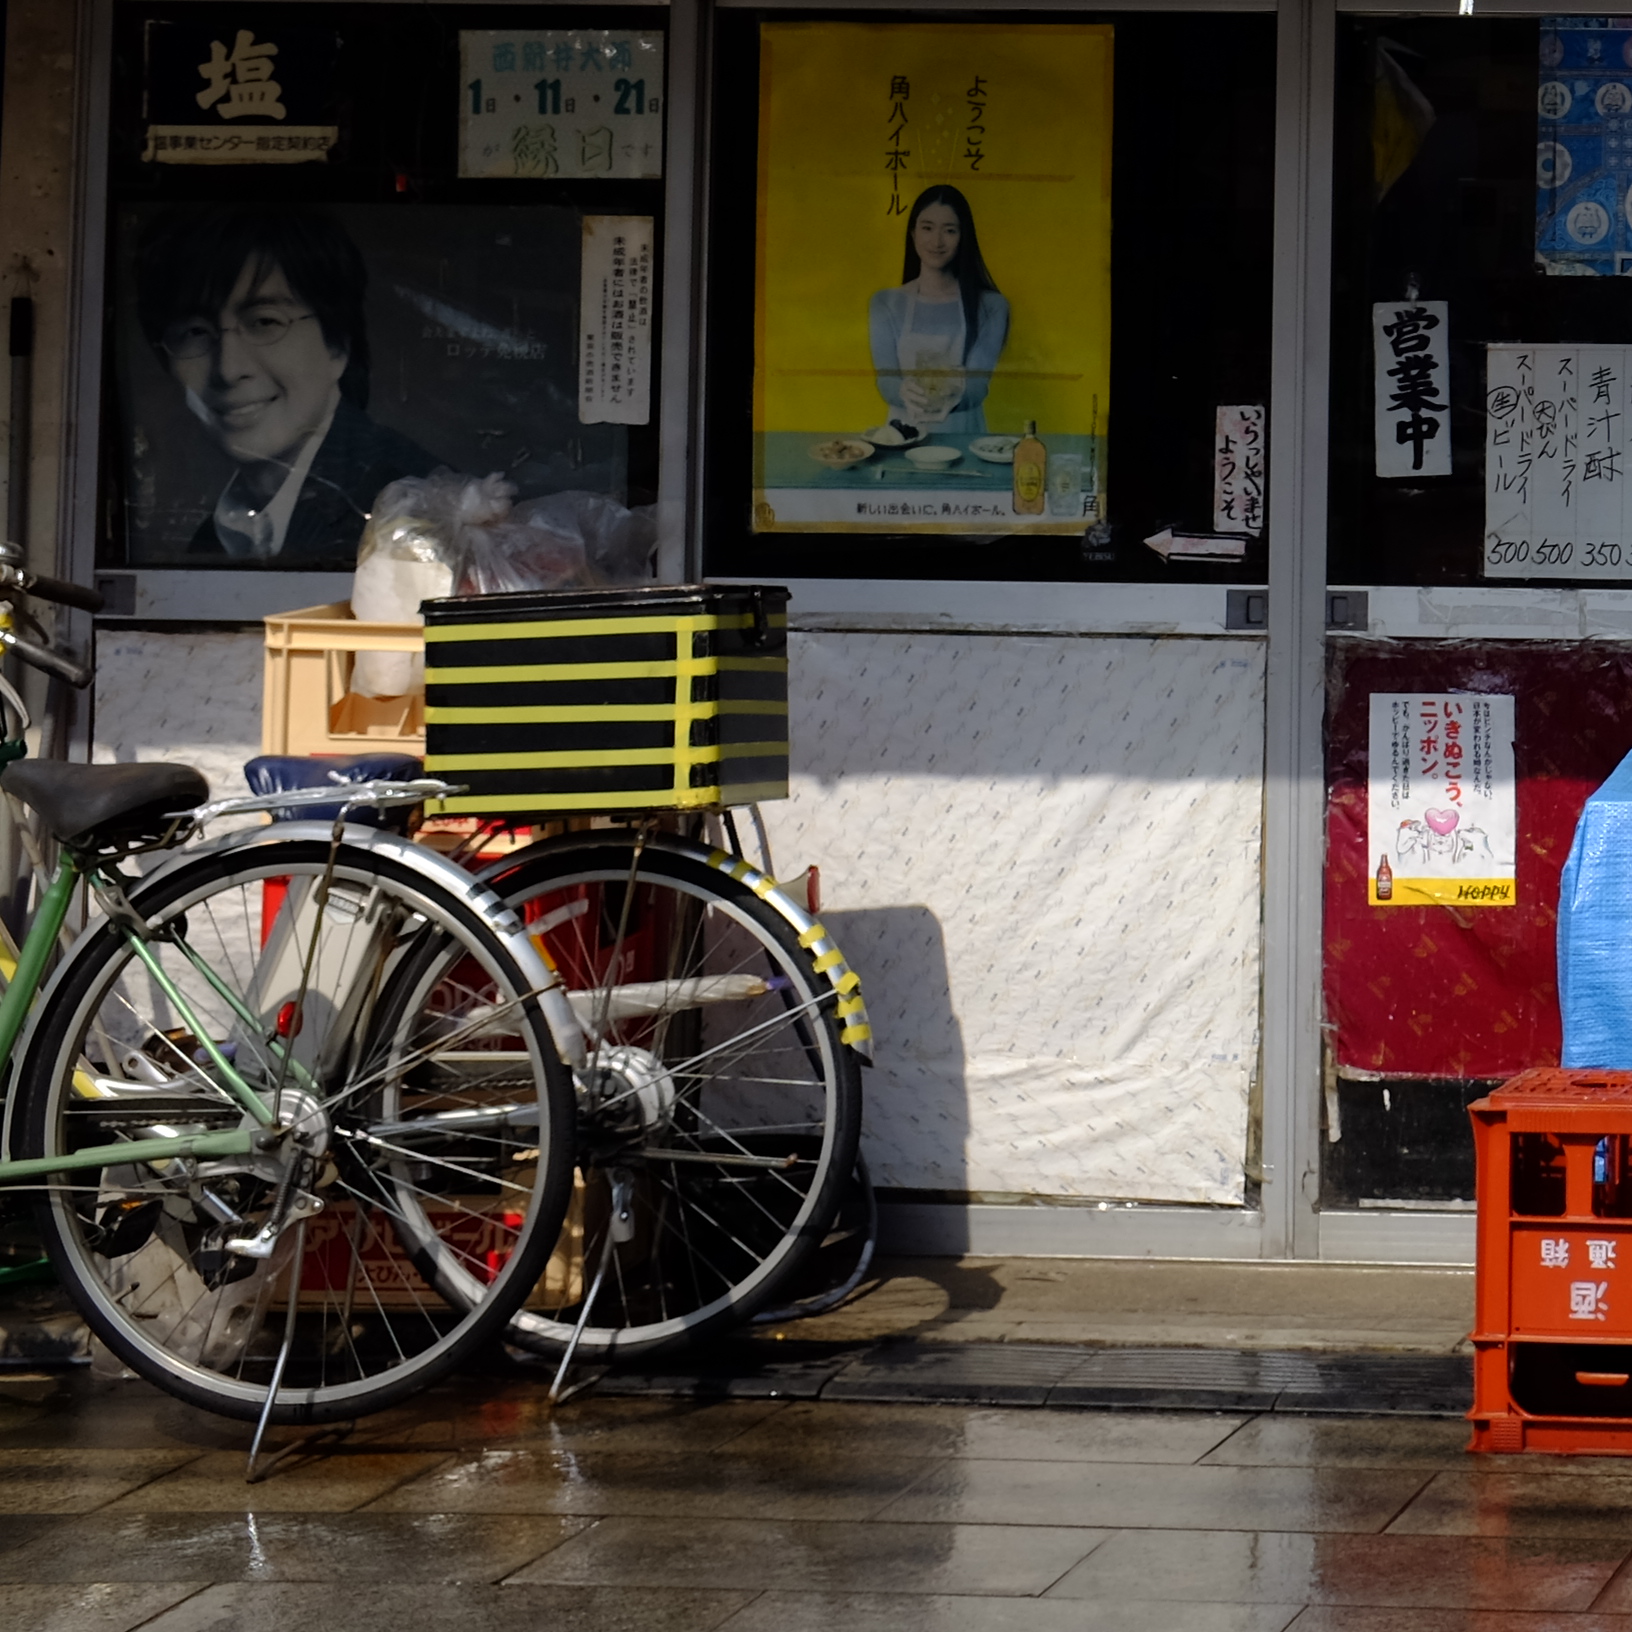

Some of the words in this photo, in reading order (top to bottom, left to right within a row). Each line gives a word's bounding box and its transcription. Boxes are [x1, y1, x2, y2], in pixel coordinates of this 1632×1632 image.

[195, 29, 288, 121] 塩
[963, 75, 988, 171] ようこそ
[885, 75, 911, 216] 角ハイボール
[1383, 307, 1449, 471] 営業中
[1516, 354, 1535, 505] スーパードライ
[1557, 357, 1578, 508] スーパードライ
[1486, 541, 1529, 566] 500
[1531, 541, 1574, 566] 500
[1581, 542, 1622, 566] 350
[1419, 701, 1439, 780] ニッポン。
[1444, 701, 1463, 808] いきぬこう、
